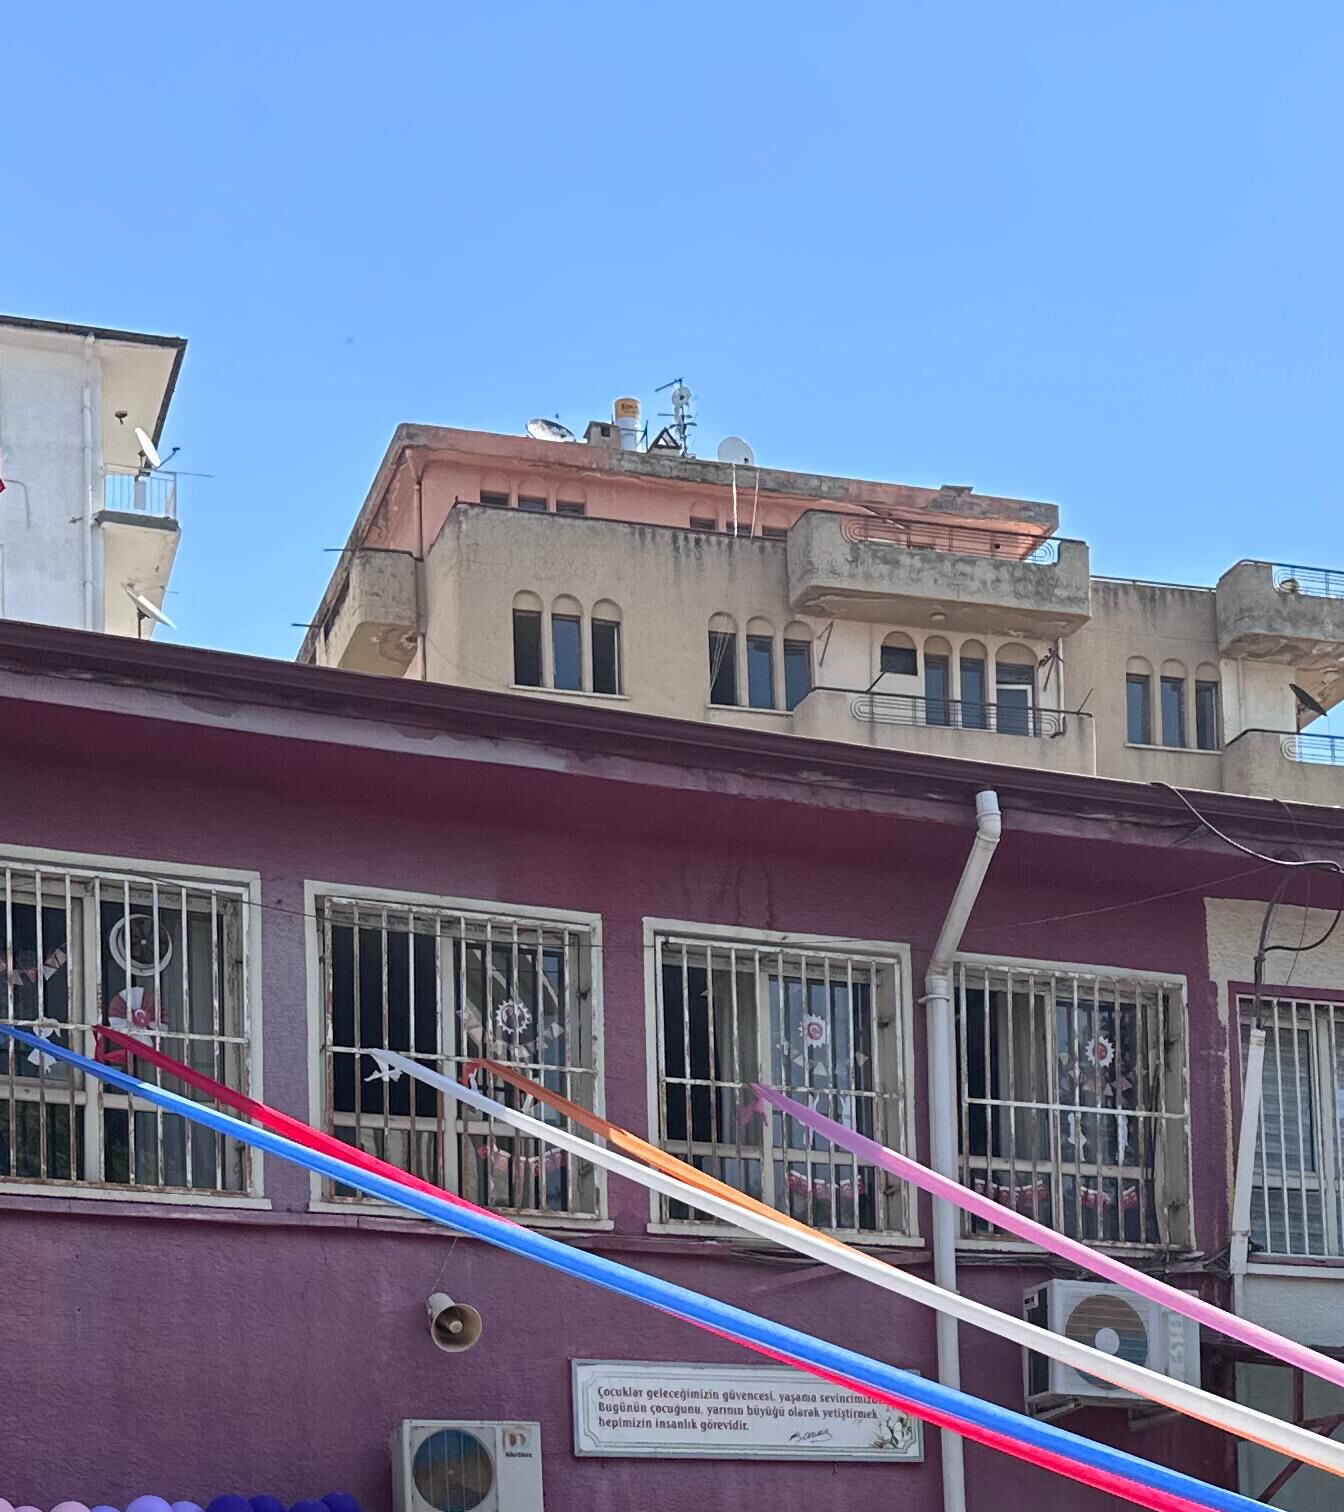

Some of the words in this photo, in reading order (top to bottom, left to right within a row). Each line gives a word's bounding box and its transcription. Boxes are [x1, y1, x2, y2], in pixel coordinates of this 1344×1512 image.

[597, 1386, 643, 1399] Çocuklar
[646, 1387, 719, 1401] geleceğimizin
[778, 1393, 817, 1404] yaşama
[598, 1401, 647, 1414] Bugünün
[707, 1406, 744, 1417] yarının
[747, 1405, 785, 1419] büyüğü
[788, 1407, 820, 1418] olarak
[822, 1408, 878, 1420] yetiştirmek
[599, 1416, 652, 1429] hepimizin
[655, 1418, 697, 1430] insanlık
